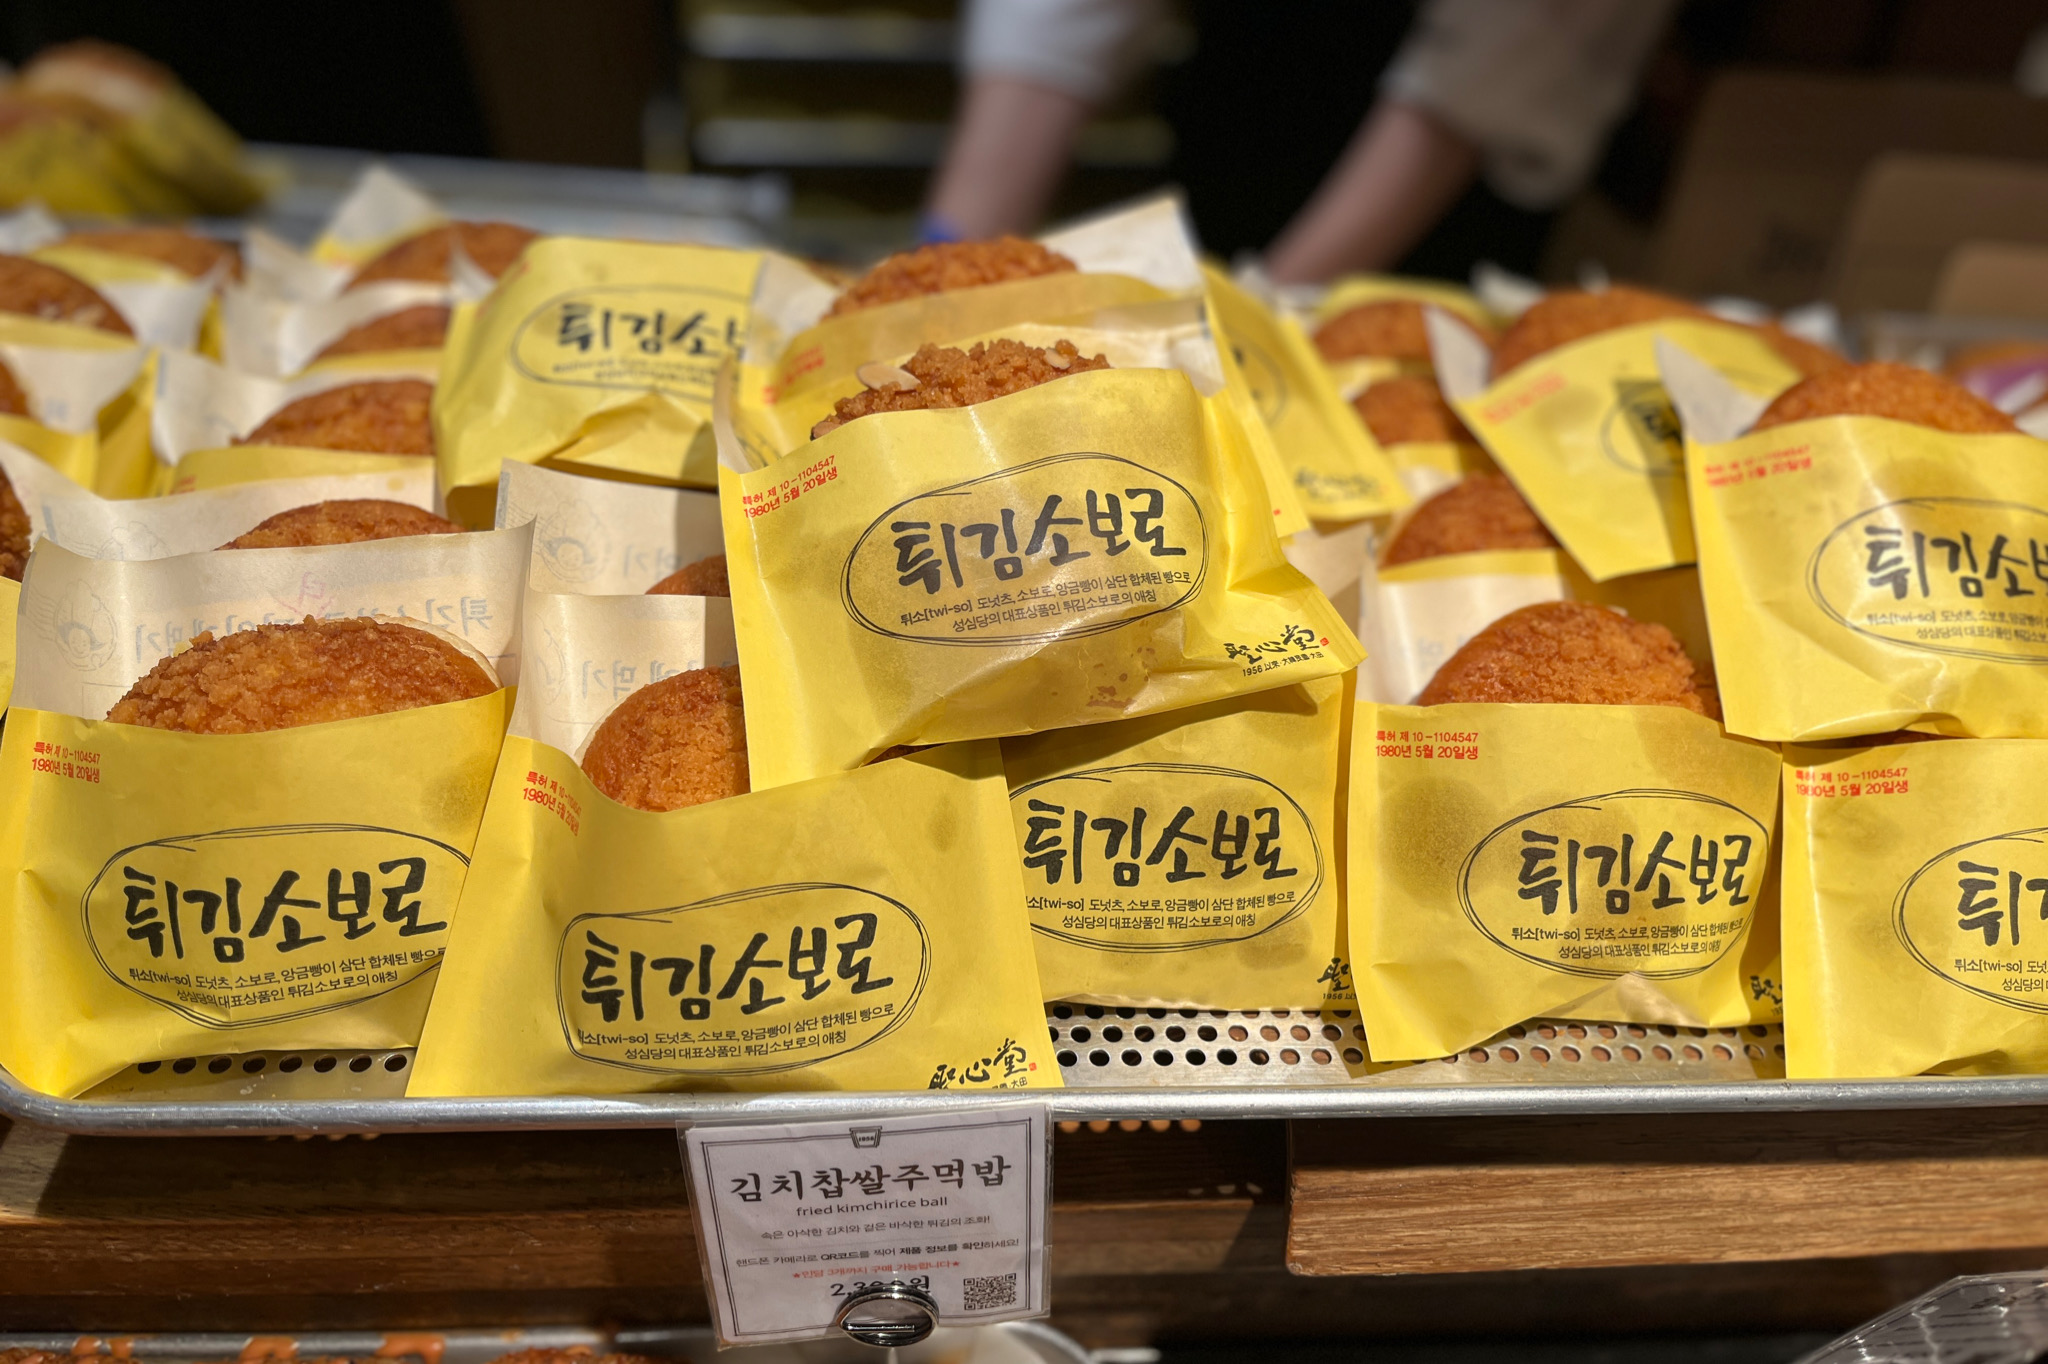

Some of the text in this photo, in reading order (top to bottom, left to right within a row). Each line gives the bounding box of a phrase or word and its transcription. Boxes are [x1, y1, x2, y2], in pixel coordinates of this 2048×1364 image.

[742, 492, 764, 506] 특허
[767, 486, 777, 498] 제
[744, 466, 838, 518] 1980년 5월 20일생
[890, 486, 1187, 595] 튀김소보로
[900, 570, 1192, 627] 튀소[twi-so] 도넛츠, 소보로, 앙금빵이 삼단 합체된 빵으로
[952, 588, 1157, 633] 성심당의 대표상품인 튀김소보로의 애칭
[1242, 664, 1263, 677] 1956
[1376, 730, 1396, 742] 특허
[1400, 730, 1410, 742] 제
[33, 742, 54, 756] 특허
[54, 744, 62, 758] 제
[1376, 744, 1478, 760] 1980년 5월 20일생
[32, 757, 100, 784] 1980년 5월 20일생
[526, 771, 548, 789] 특허
[550, 780, 558, 794] 제
[1820, 772, 1832, 782] 제
[524, 787, 556, 812] 1980년
[1840, 783, 1861, 796] 5월
[1866, 780, 1908, 794] 20일생
[1022, 798, 1298, 887] 튀김소보로
[1517, 829, 1752, 916] 튀김소보로
[122, 856, 448, 963] 튀김소보로
[1026, 891, 1296, 913] 소[twi-so] 도넛츠, 소보로, 앙금빵이 삼단 합체된 빵으로
[1957, 860, 2048, 947] 튀
[1062, 913, 1256, 931] 성심당의 대표상품인 튀김소보로의 애칭
[1511, 926, 1581, 942] 튀소[twi-so]
[1584, 928, 1616, 942] 도넛츠,
[1617, 927, 1650, 941] 소보로,
[1650, 926, 1688, 940] 앙금빵이
[1690, 925, 1709, 939] 삼단
[1709, 921, 1730, 937] 합체된
[1558, 945, 1602, 959] 성심당의
[1604, 944, 1650, 958] 대표상품인
[1652, 941, 1708, 956] 튀김소보로의
[128, 966, 192, 988] 튀소[twi-so]
[195, 974, 234, 991] 도넛츠,
[234, 970, 281, 989] 소보로,
[280, 961, 336, 983] 앙금빵이
[338, 958, 367, 976] 삼단
[368, 952, 409, 970] 합체된
[580, 912, 894, 1024] 튀김소보로
[1954, 958, 2048, 974] 튀소[twi-so] 도넛
[176, 970, 399, 1009] 성심당의 대표상품인 튀김소보로의 애칭
[2001, 978, 2044, 992] 성심당의
[654, 1030, 696, 1045] 도넛츠,
[697, 1028, 741, 1043] 소보로,
[740, 1022, 792, 1042] 앙금빵이
[794, 1018, 819, 1036] 삼단
[820, 1010, 858, 1029] 합체된
[859, 1002, 896, 1022] 빵으로
[624, 1030, 848, 1060] 성심당의 대표상품인 튀김소보로의 애칭
[730, 1154, 1012, 1203] 김치찹쌀주먹밥
[796, 1196, 948, 1217] fried kimchirice ball
[761, 1230, 785, 1240] 속은
[787, 1227, 823, 1238] 아삭한
[826, 1224, 860, 1236] 김치와
[889, 1220, 924, 1230] 바삭한
[928, 1217, 962, 1228] 튀김의
[964, 1215, 990, 1226] 조화!
[736, 1256, 770, 1268] 핸드폰
[773, 1254, 819, 1265] 카메라로
[820, 1250, 870, 1261] QR코드를
[900, 1246, 922, 1255] 제품
[925, 1244, 958, 1254] 정보를
[962, 1238, 1020, 1250] 확인하세요!
[872, 1264, 893, 1273] 구매
